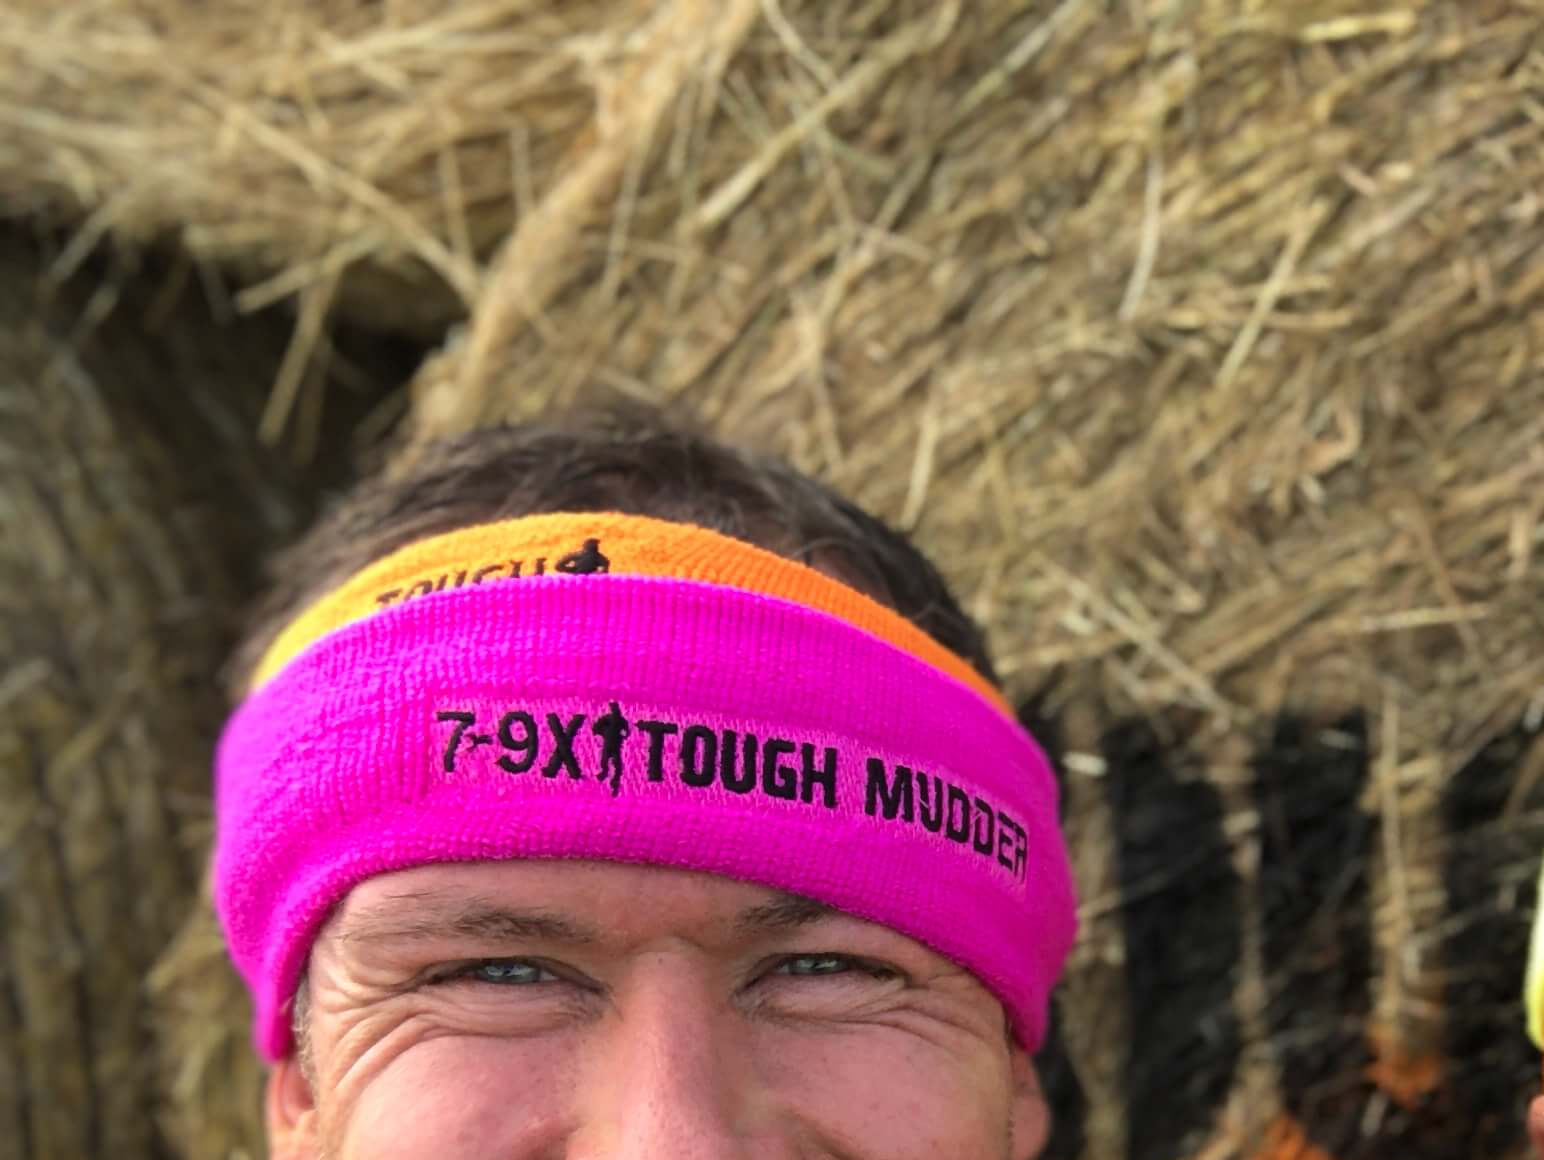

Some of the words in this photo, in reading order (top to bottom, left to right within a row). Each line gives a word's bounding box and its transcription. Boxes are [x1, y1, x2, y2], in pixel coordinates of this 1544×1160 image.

[436, 711, 586, 780] 7-9X
[635, 719, 838, 809] TOUGH
[864, 757, 1029, 884] MUDDER
